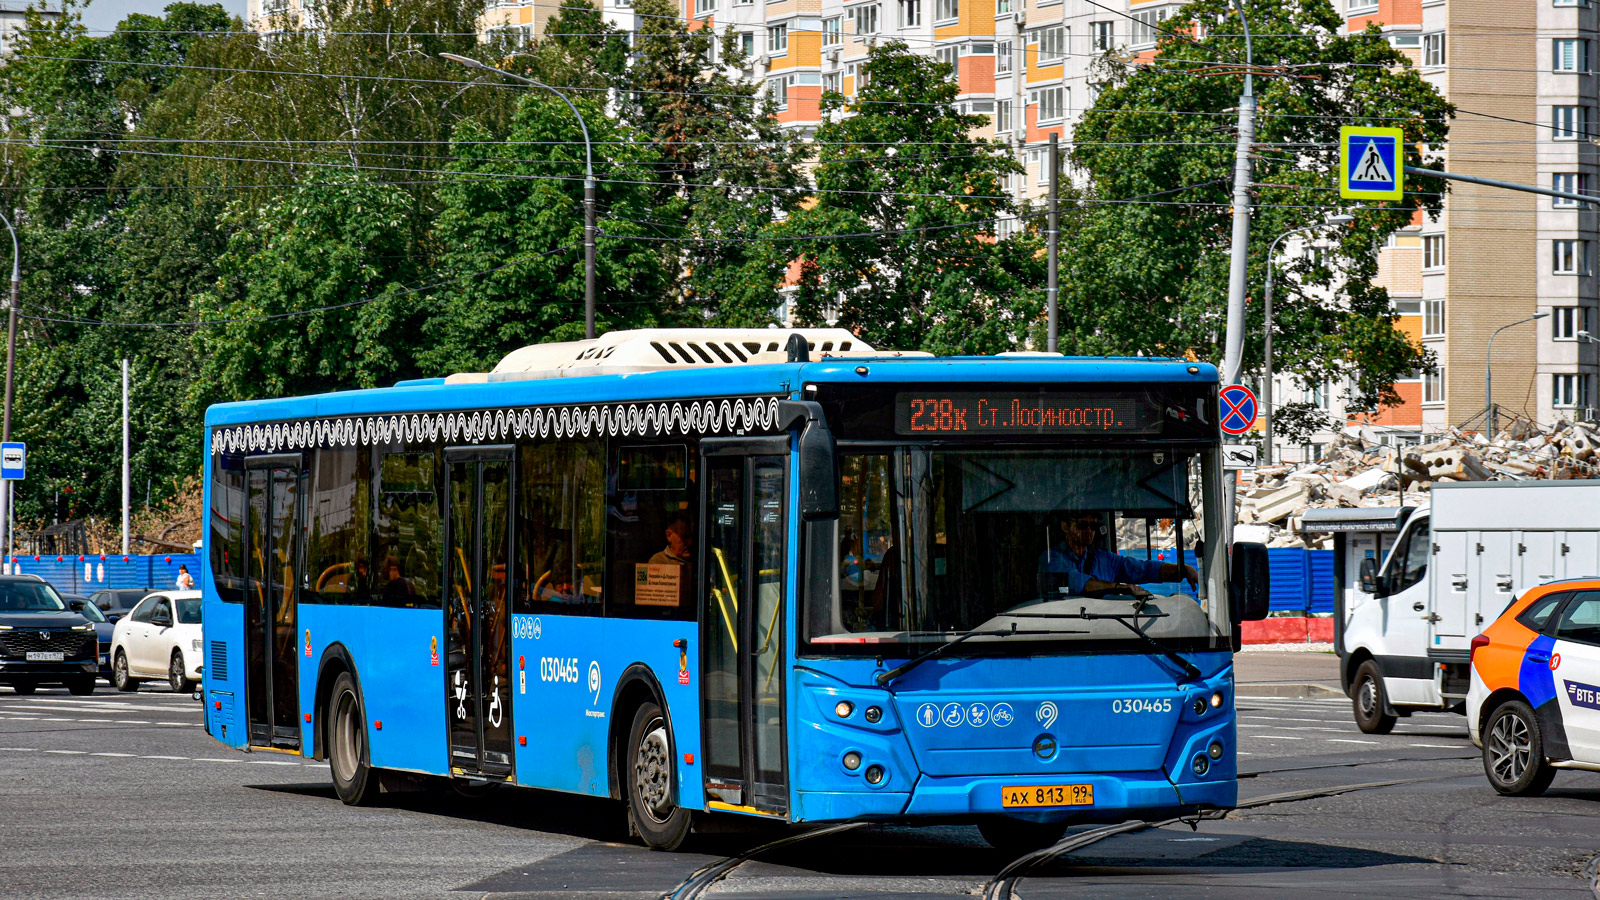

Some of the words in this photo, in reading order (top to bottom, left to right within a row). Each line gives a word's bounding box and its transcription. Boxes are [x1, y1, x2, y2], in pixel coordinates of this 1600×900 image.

[911, 399, 967, 430] 238к
[540, 656, 579, 683] 030465
[1576, 688, 1594, 703] ВТБ
[1112, 698, 1172, 713] 030465
[1035, 788, 1064, 804] 813
[1072, 786, 1088, 798] 99
